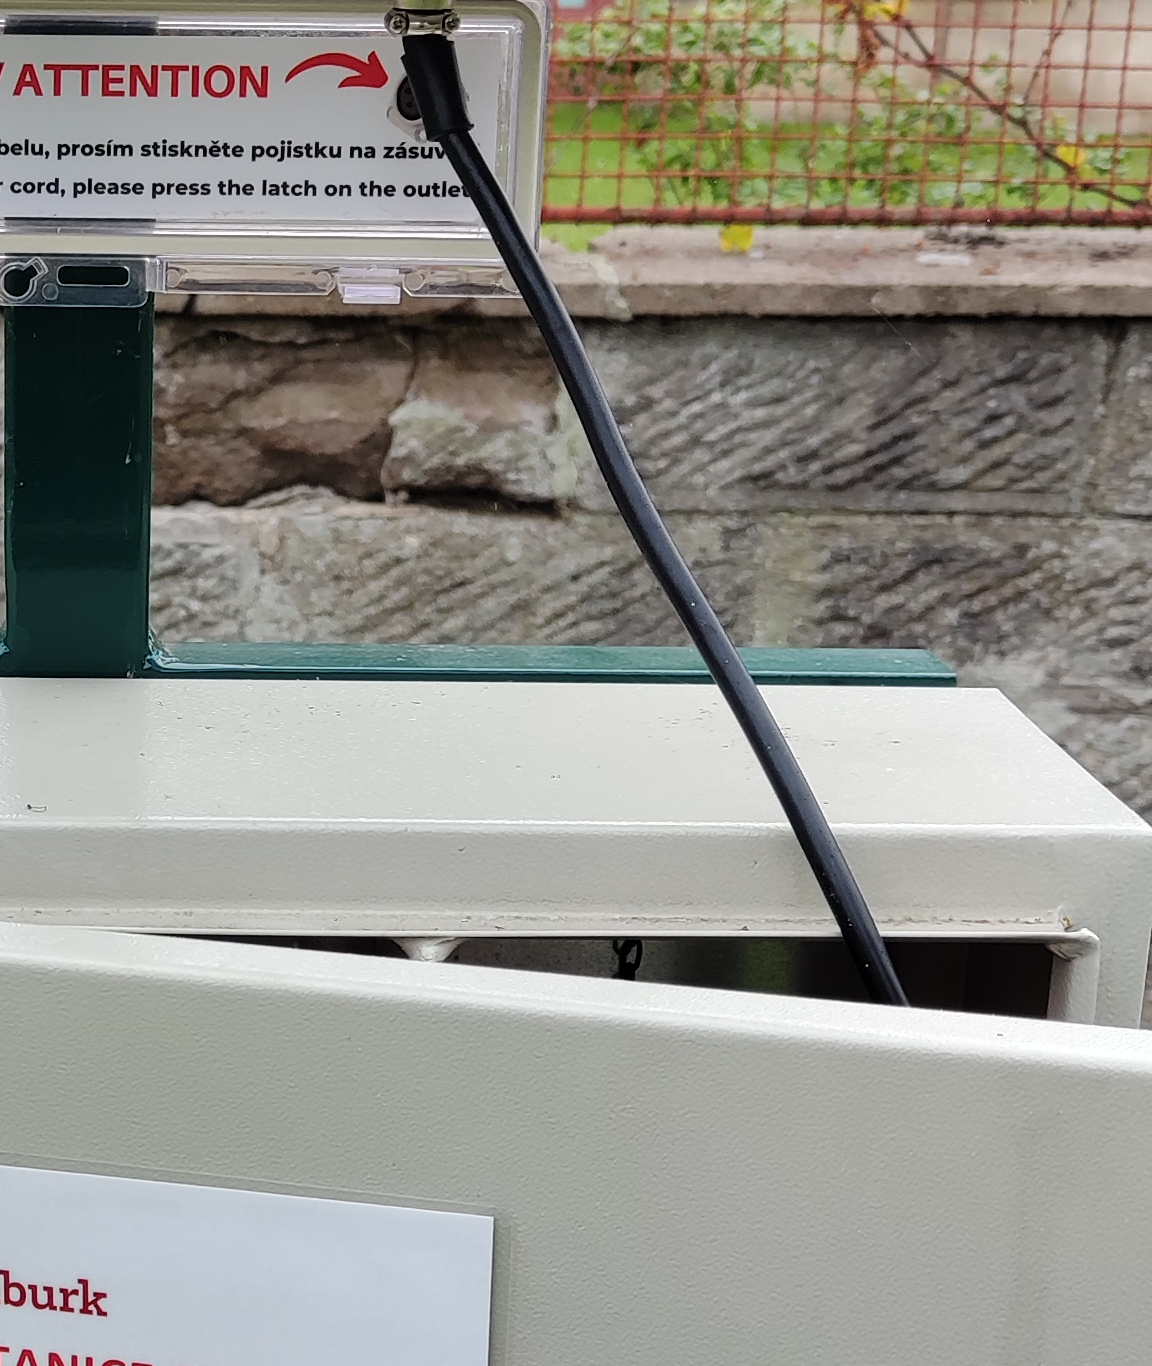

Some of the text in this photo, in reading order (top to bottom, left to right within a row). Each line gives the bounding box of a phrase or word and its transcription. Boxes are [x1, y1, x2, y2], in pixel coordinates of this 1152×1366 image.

[13, 63, 270, 99] ATTENTION
[57, 139, 133, 160] prosím
[141, 139, 244, 158] stiskněte
[251, 140, 342, 162] pojistku
[350, 146, 376, 159] na
[383, 142, 446, 160] zásuv
[10, 178, 65, 198] cord,
[73, 178, 144, 198] please
[152, 183, 211, 199] press
[217, 179, 255, 196] the
[262, 179, 317, 196] latch
[324, 184, 352, 197] on
[359, 180, 396, 197] the
